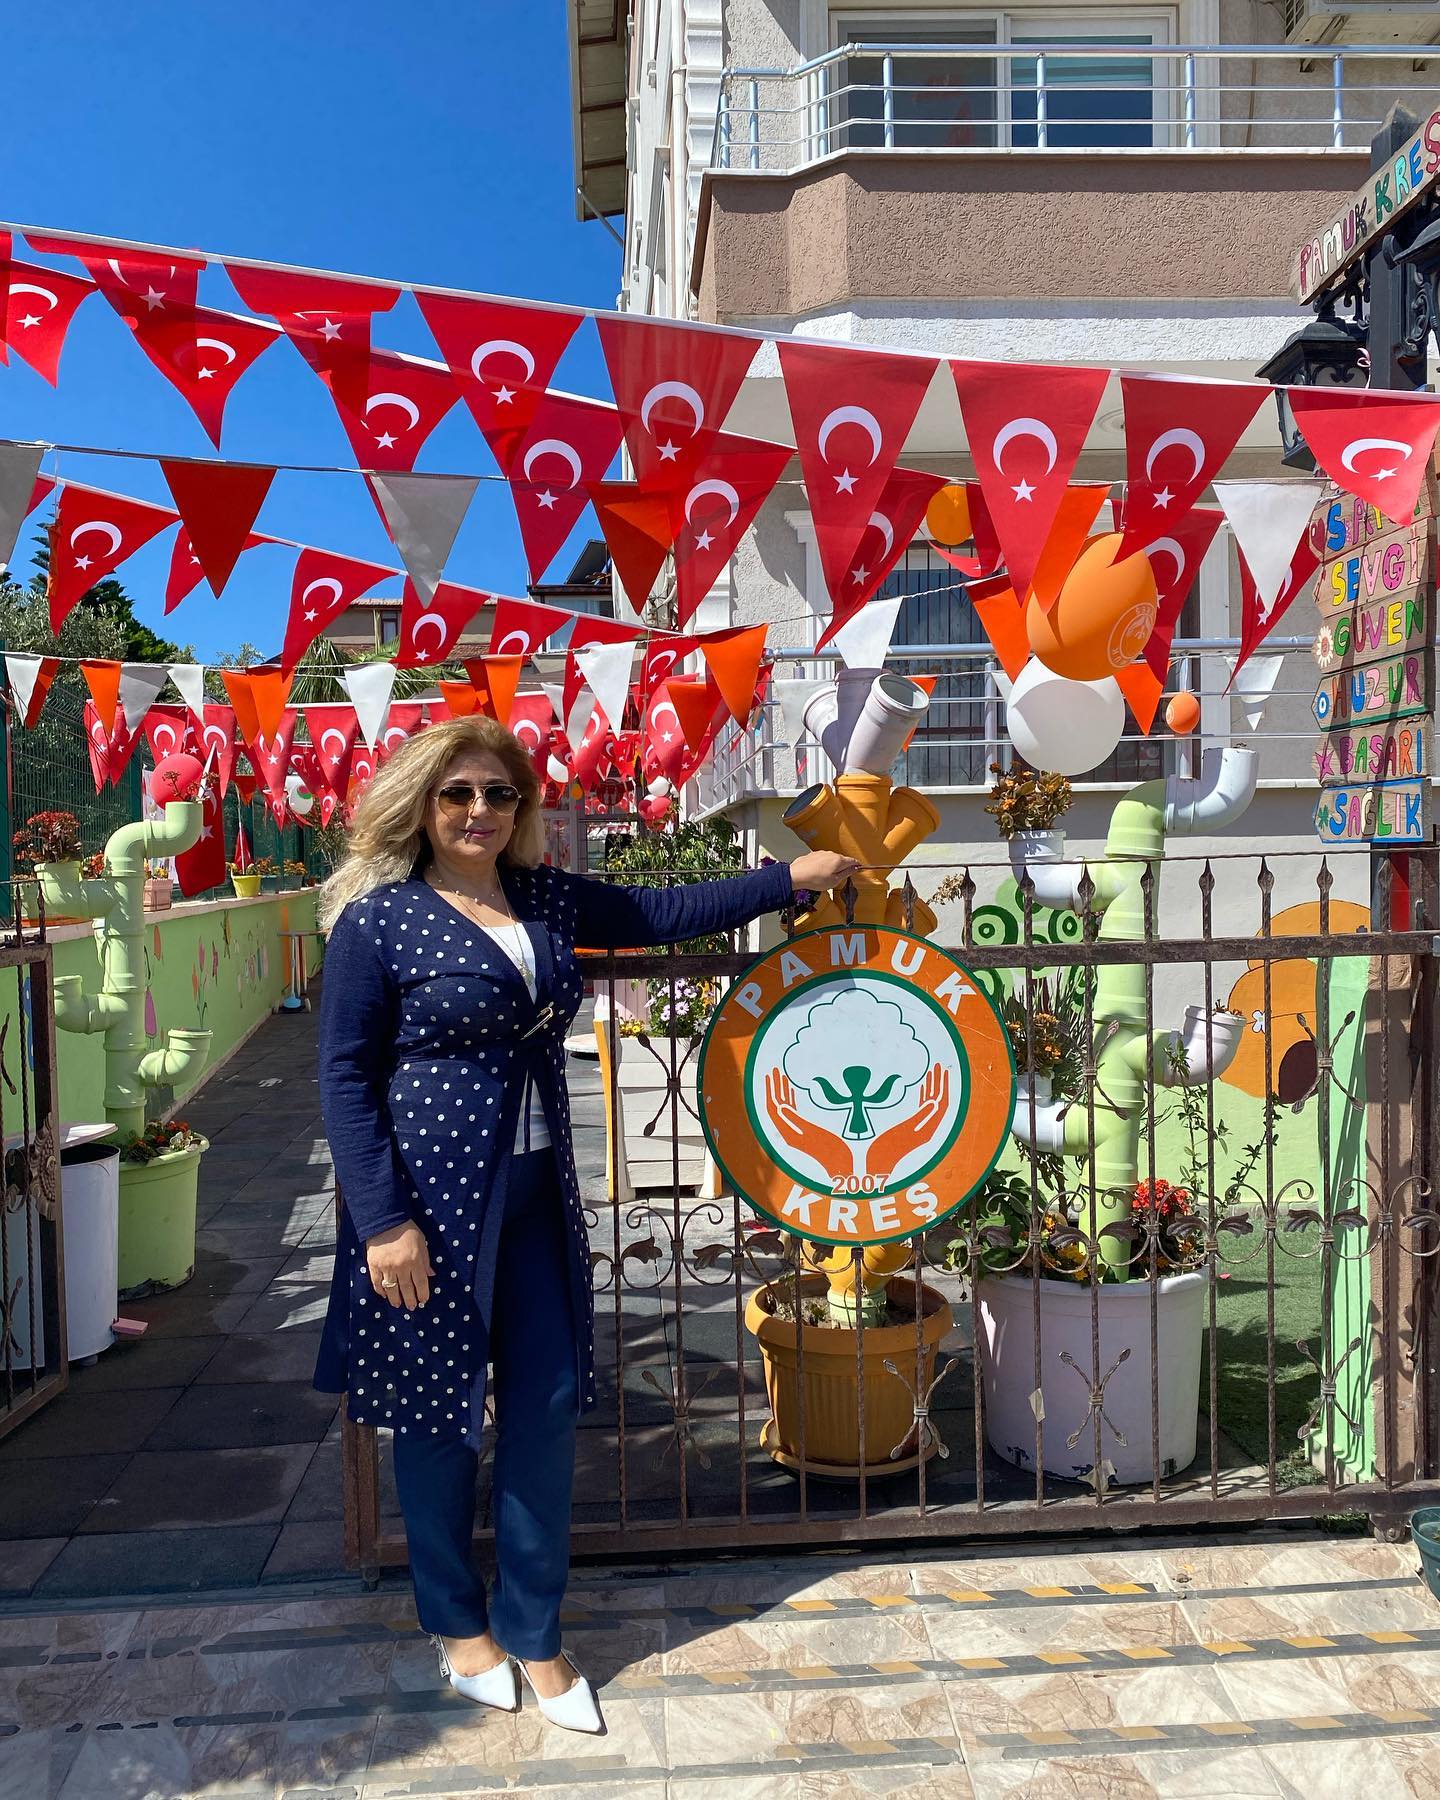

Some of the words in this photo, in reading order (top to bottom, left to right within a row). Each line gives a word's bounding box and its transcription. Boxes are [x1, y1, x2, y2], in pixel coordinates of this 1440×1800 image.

[1300, 197, 1368, 295] PAMUK
[1332, 657, 1422, 718] HUZUR
[734, 933, 977, 1019] PAMUK
[781, 1182, 939, 1234] KREŞ
[831, 1174, 891, 1195] 2007
